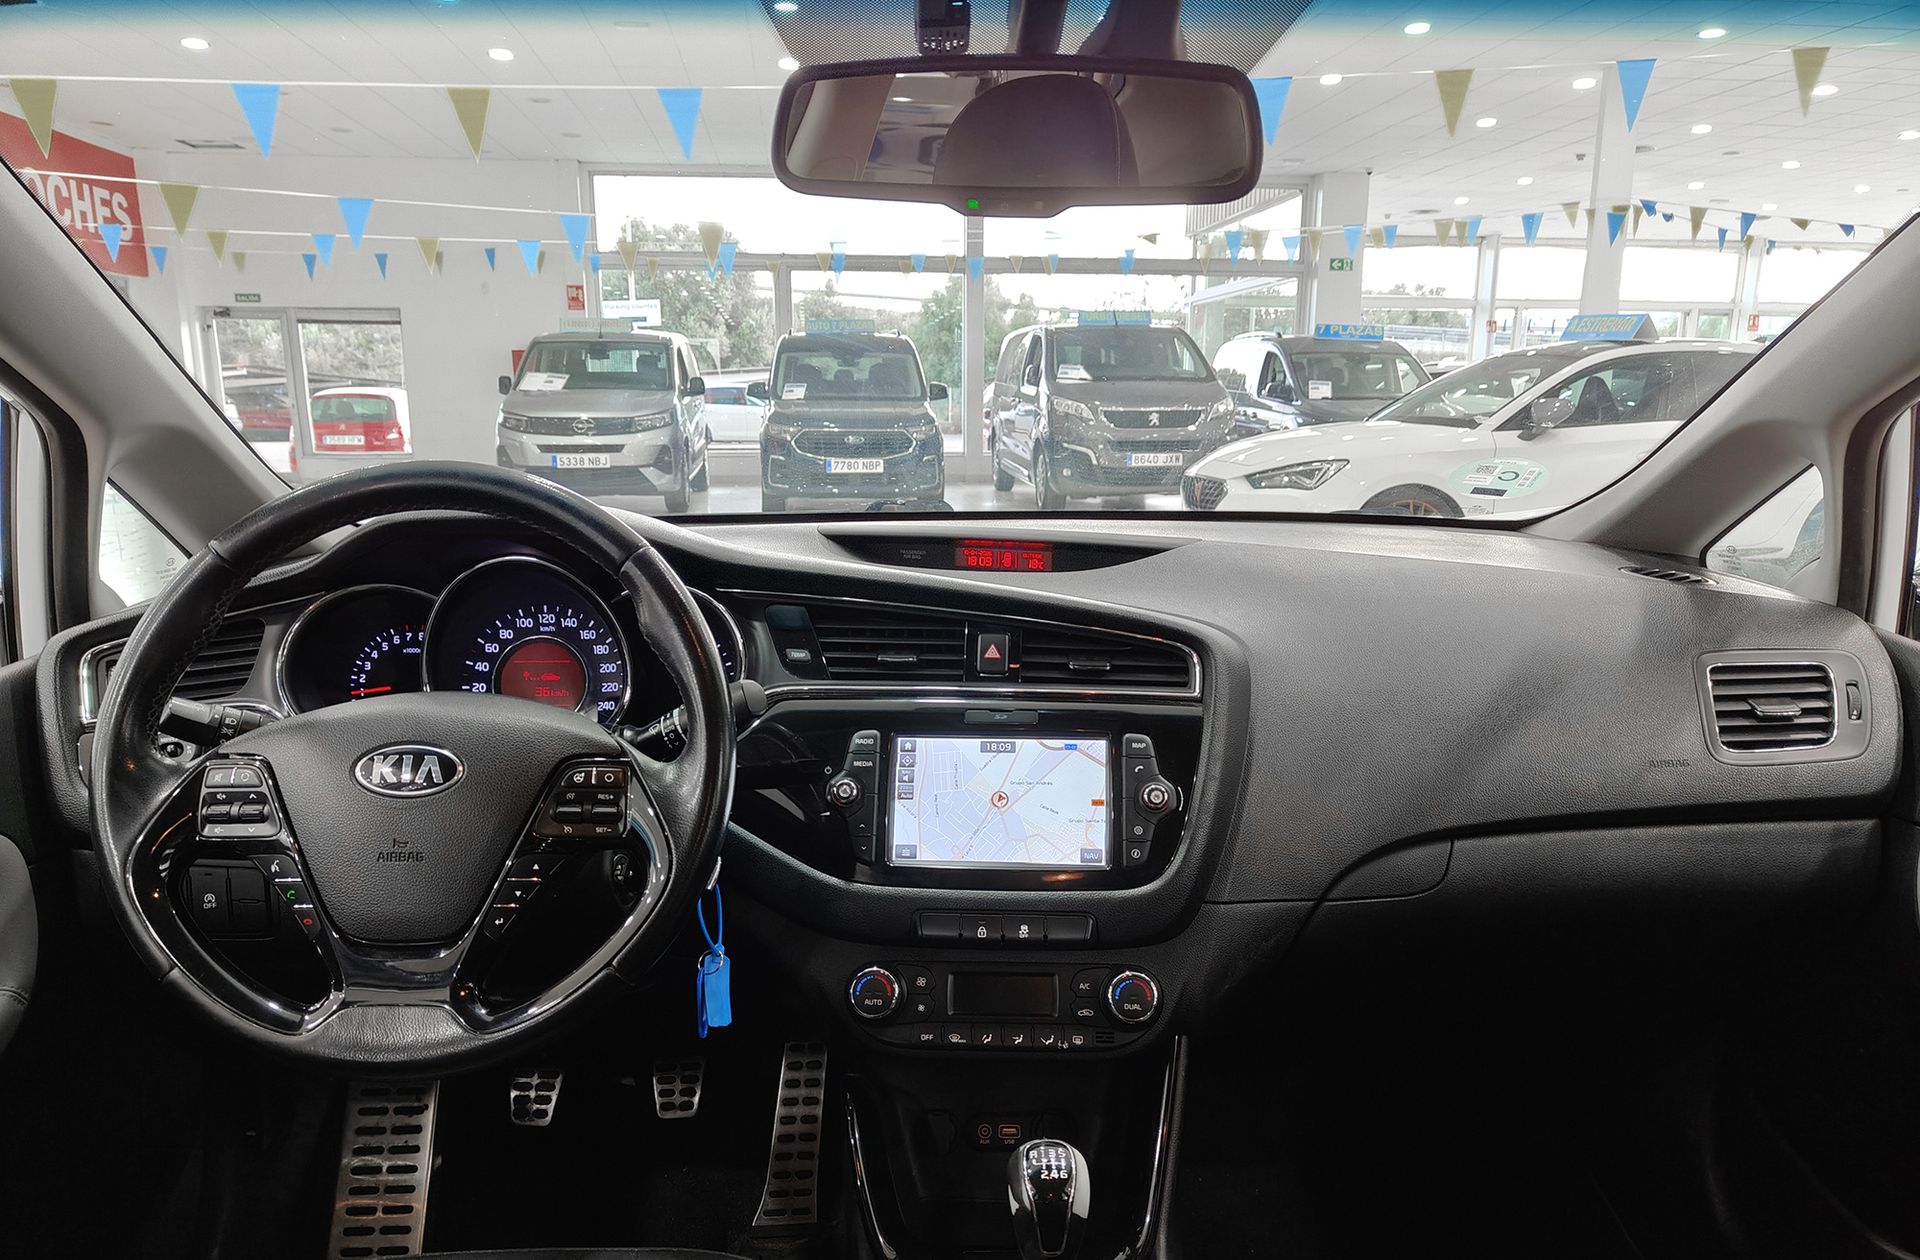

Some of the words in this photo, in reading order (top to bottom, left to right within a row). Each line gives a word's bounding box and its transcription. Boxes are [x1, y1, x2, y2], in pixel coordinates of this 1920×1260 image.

[1319, 325, 1326, 334] 7
[1330, 325, 1383, 336] PLAZAS
[559, 456, 585, 466] 5338
[588, 456, 608, 466] NBJ
[1134, 454, 1158, 464] 8640
[1163, 454, 1181, 464] JXW
[833, 461, 859, 471] 7780
[862, 461, 882, 471] NBP
[515, 618, 533, 628] 100
[539, 614, 555, 623] 120
[561, 618, 577, 628] 140
[406, 633, 412, 642] 7
[500, 630, 514, 639] 80
[580, 630, 596, 639] 160
[393, 636, 400, 645] 6
[382, 643, 388, 651] 5
[485, 644, 499, 653] 60
[593, 645, 609, 654] 180
[371, 651, 378, 659] 4
[364, 662, 371, 670] 3
[475, 662, 489, 671] 40
[600, 663, 617, 672] 200
[359, 674, 366, 683] 2
[472, 683, 486, 692] 20
[535, 686, 550, 697] 36
[602, 683, 618, 692] 220
[598, 701, 615, 711] 240
[986, 742, 1011, 751] 18:09
[1650, 758, 1690, 768] AIRBAG
[372, 755, 443, 783] KIA
[377, 852, 424, 862] AIRBAG
[864, 998, 883, 1006] AUTO
[1030, 1150, 1038, 1158] R
[1048, 1149, 1056, 1157] 3
[1040, 1170, 1049, 1179] 2
[1050, 1169, 1060, 1179] 4
[1060, 1170, 1068, 1178] 6
